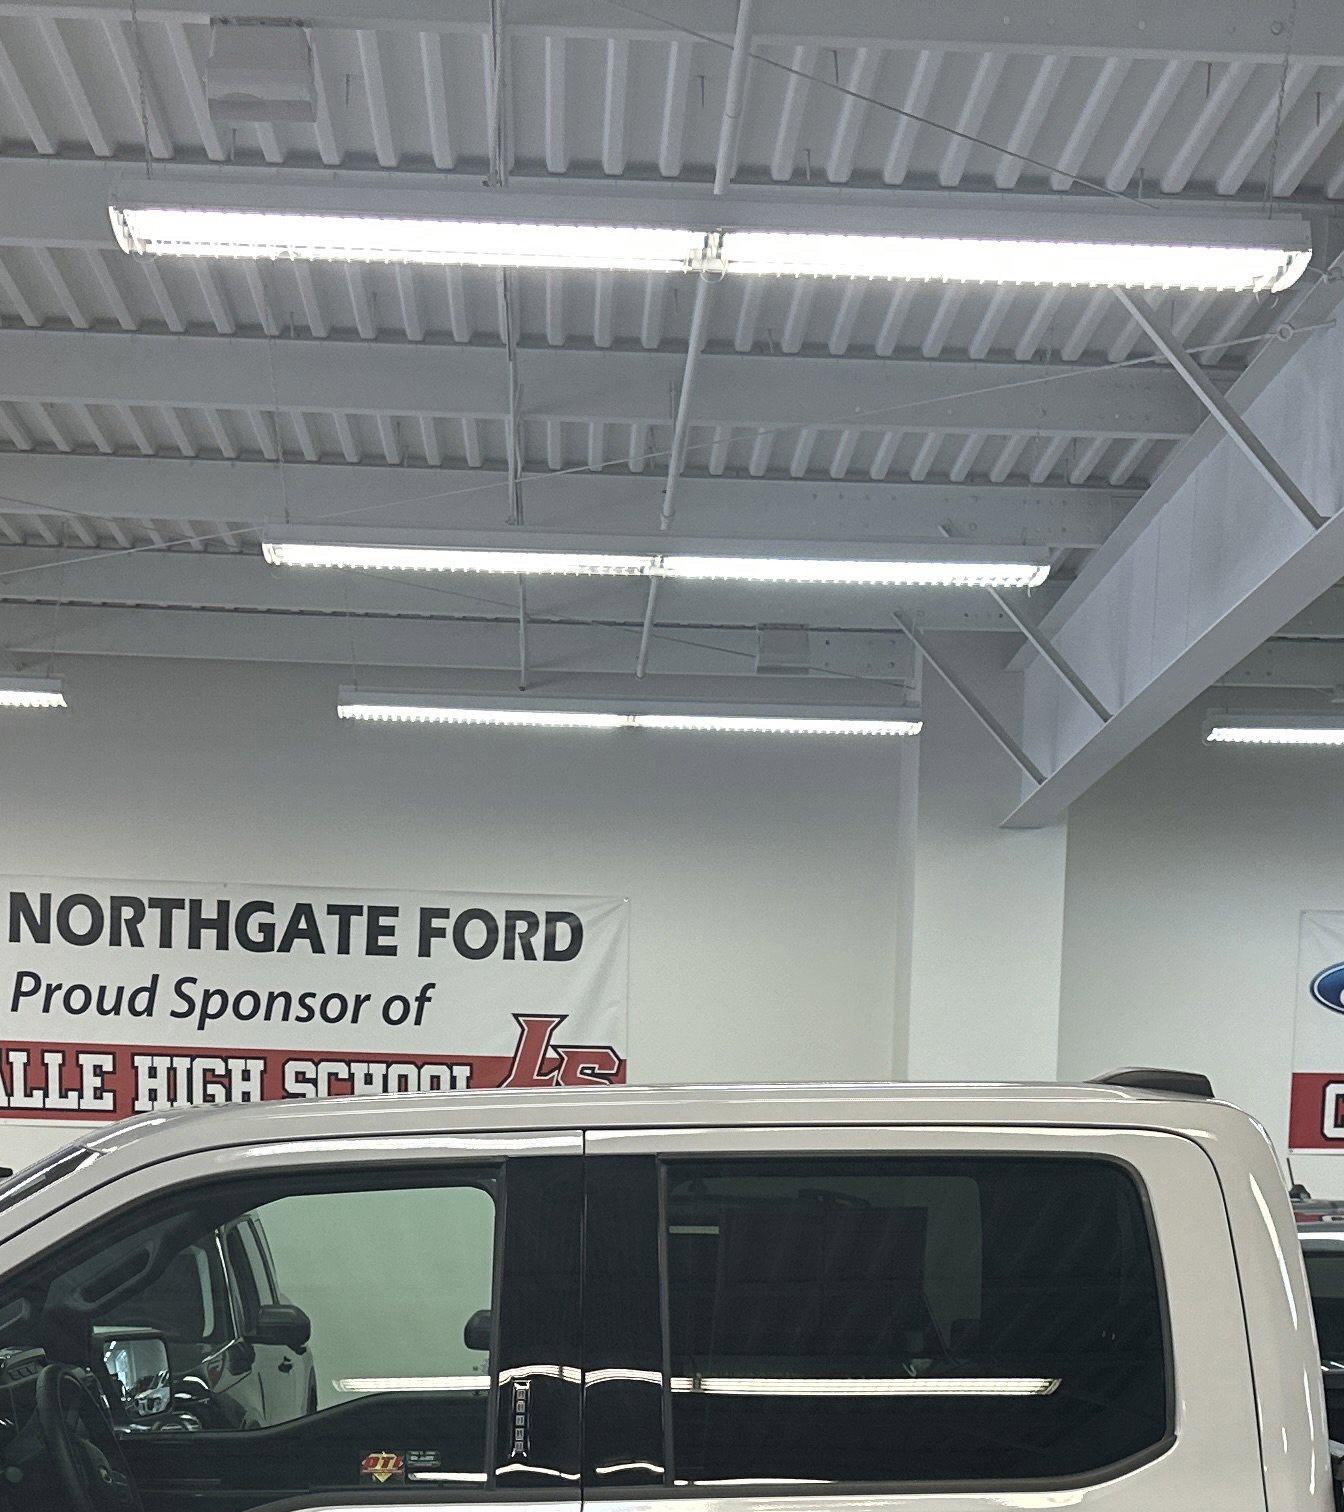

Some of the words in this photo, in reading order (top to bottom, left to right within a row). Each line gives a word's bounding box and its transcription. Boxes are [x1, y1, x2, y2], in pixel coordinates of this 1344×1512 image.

[8, 891, 399, 957] NORTHGATE
[418, 906, 583, 962] FORD
[10, 971, 160, 1018] Proud
[170, 976, 371, 1031] Sponsor
[381, 982, 436, 1027] of
[132, 1054, 265, 1111] HIGH
